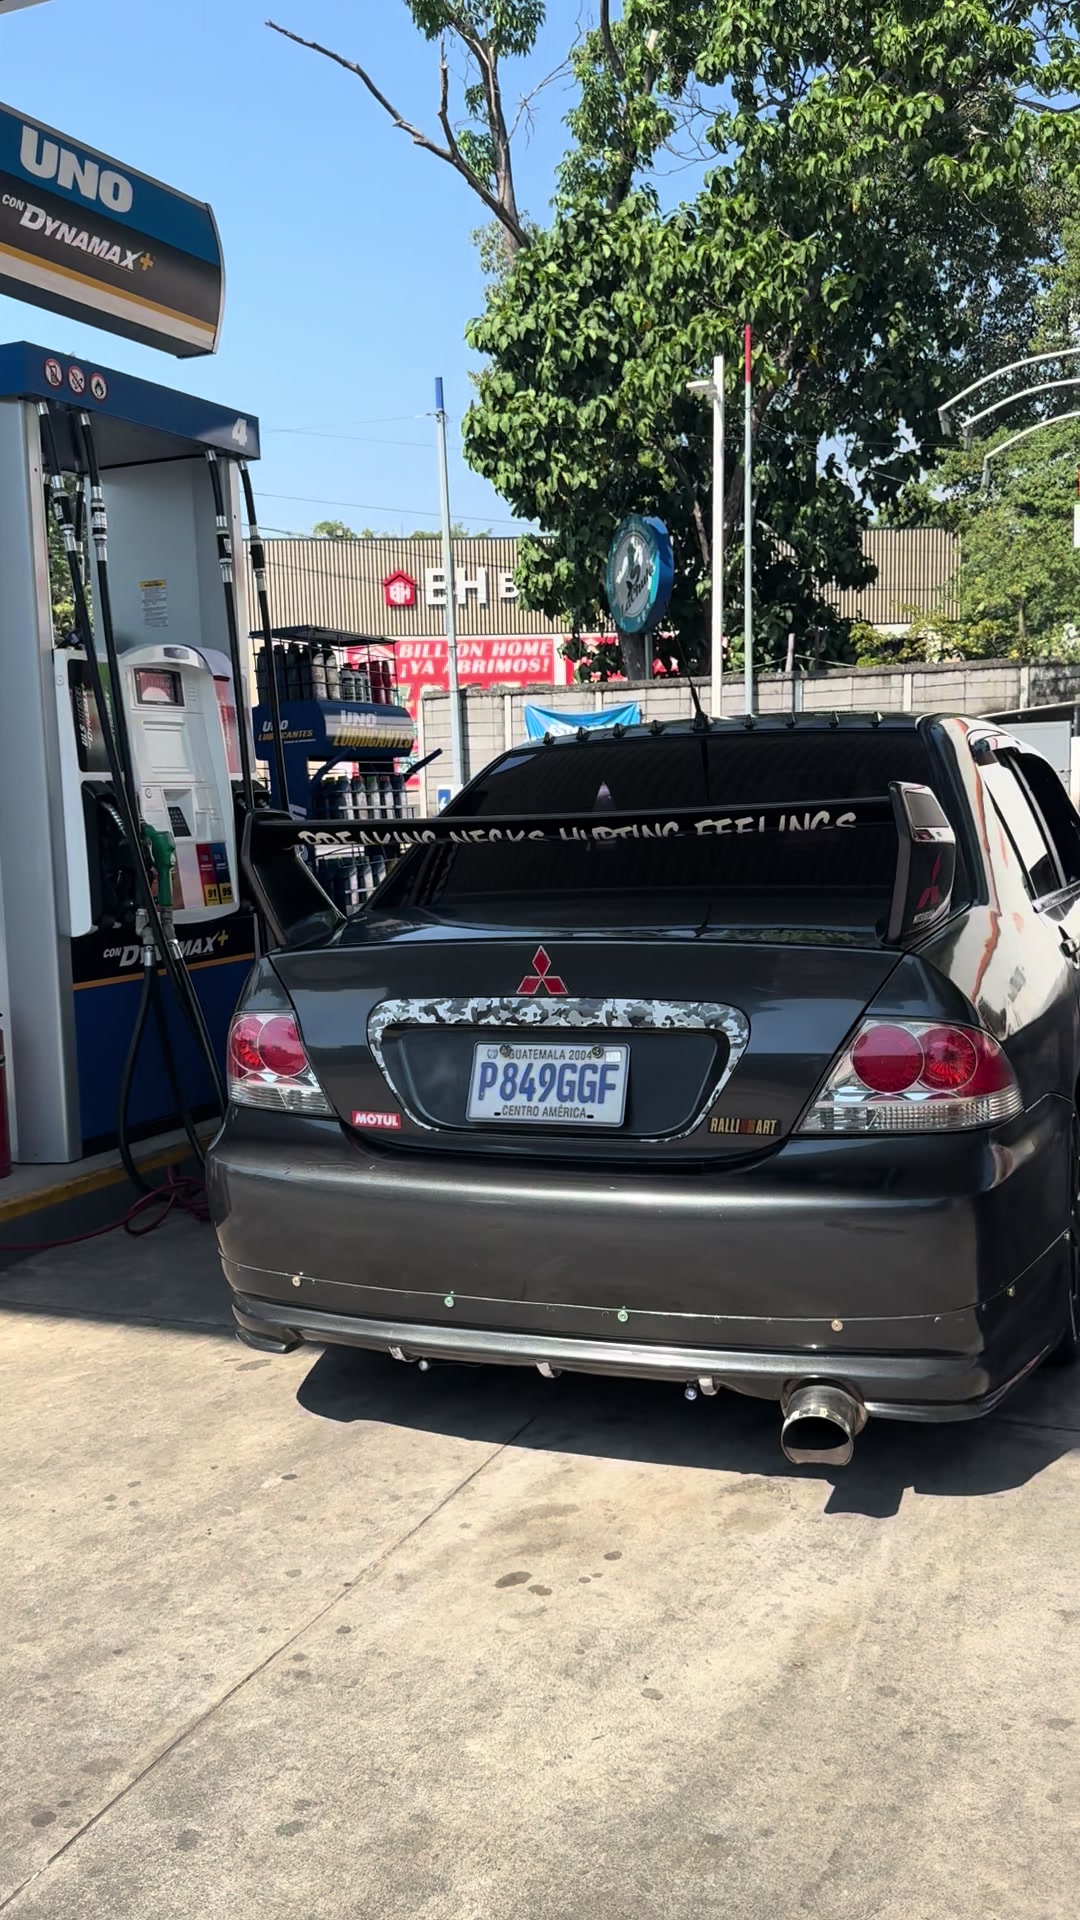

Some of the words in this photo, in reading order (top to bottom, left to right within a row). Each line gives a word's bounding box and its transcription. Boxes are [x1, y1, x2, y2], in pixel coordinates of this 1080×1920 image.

[20, 124, 134, 214] UNO
[2, 194, 25, 212] CON
[231, 417, 248, 446] 4
[399, 642, 484, 658] BILLON
[491, 641, 553, 657] HOME
[401, 660, 435, 678] ¡YA
[262, 719, 289, 732] UO
[340, 709, 377, 727] UNO
[258, 729, 313, 741] LUBCANTES
[333, 727, 414, 748] LUBRICANTES
[207, 888, 217, 898] 91
[222, 886, 232, 897] 95
[103, 946, 122, 958] CON
[508, 1048, 566, 1060] GUATEMALA
[568, 1049, 593, 1061] 2004
[478, 1061, 620, 1104] P849GGF
[355, 1112, 399, 1127] MOTUL
[501, 1105, 539, 1117] CENTRO
[541, 1104, 587, 1119] AMÉRICA
